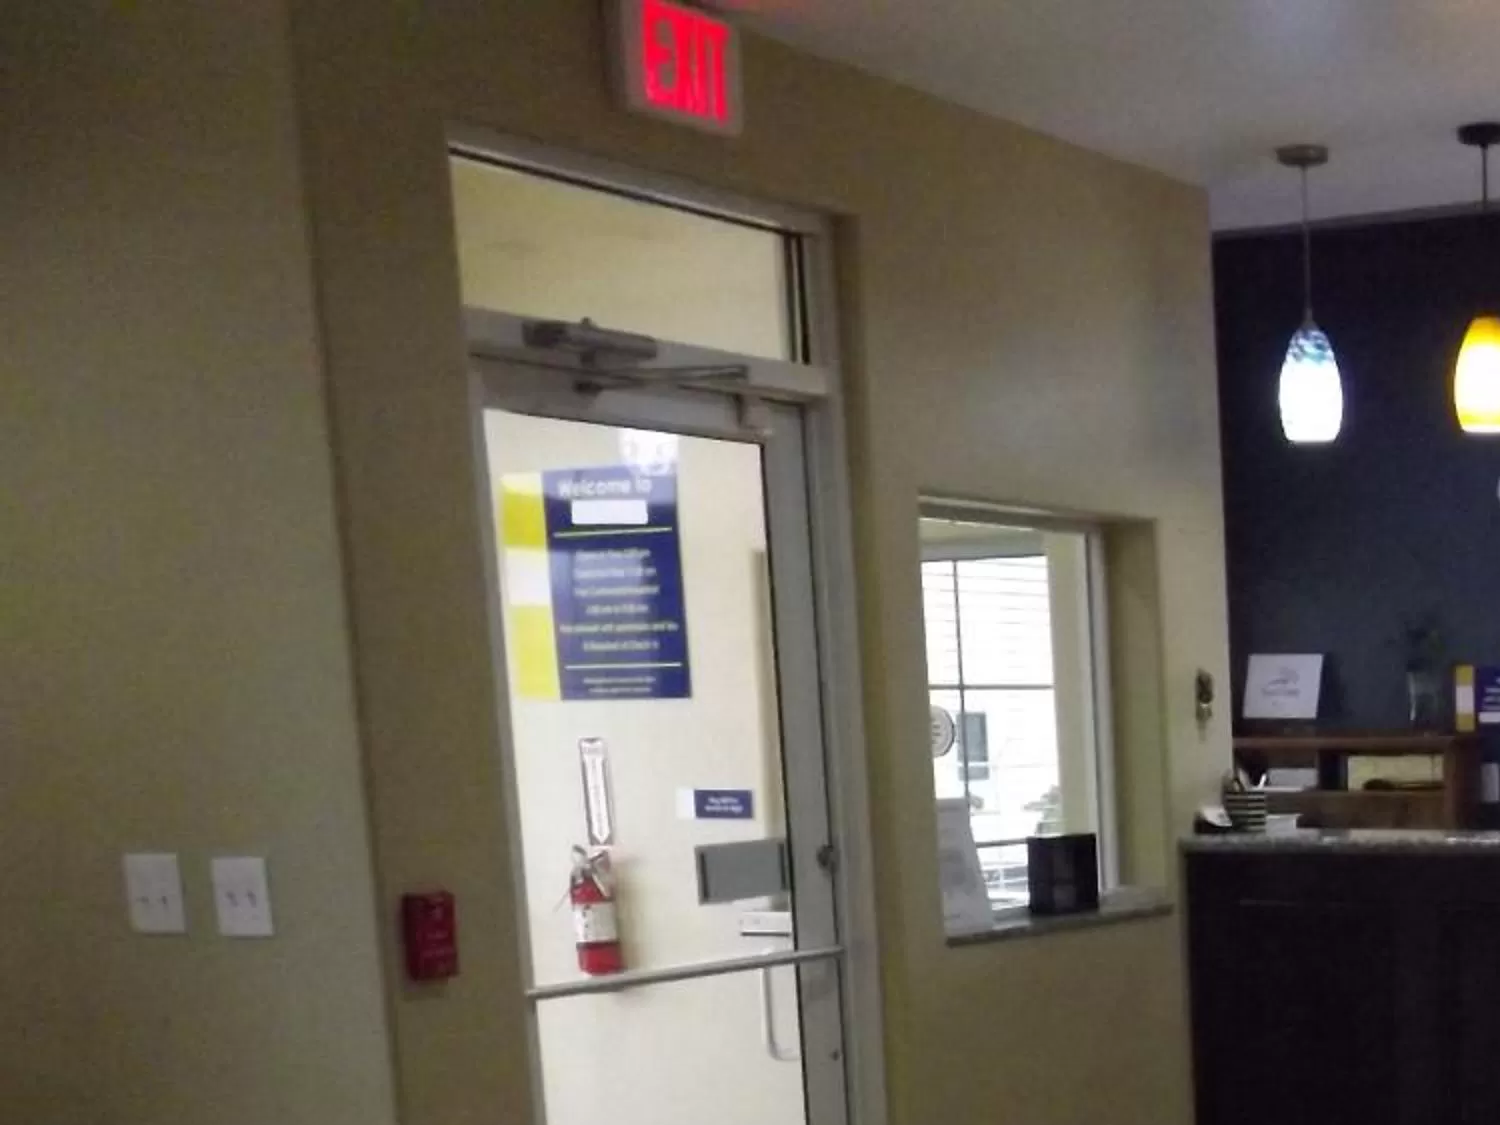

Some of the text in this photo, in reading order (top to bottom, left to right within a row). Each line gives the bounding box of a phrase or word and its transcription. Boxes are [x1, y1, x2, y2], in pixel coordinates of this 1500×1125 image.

[643, 0, 728, 125] EXIT
[558, 476, 652, 498] Welcome to
